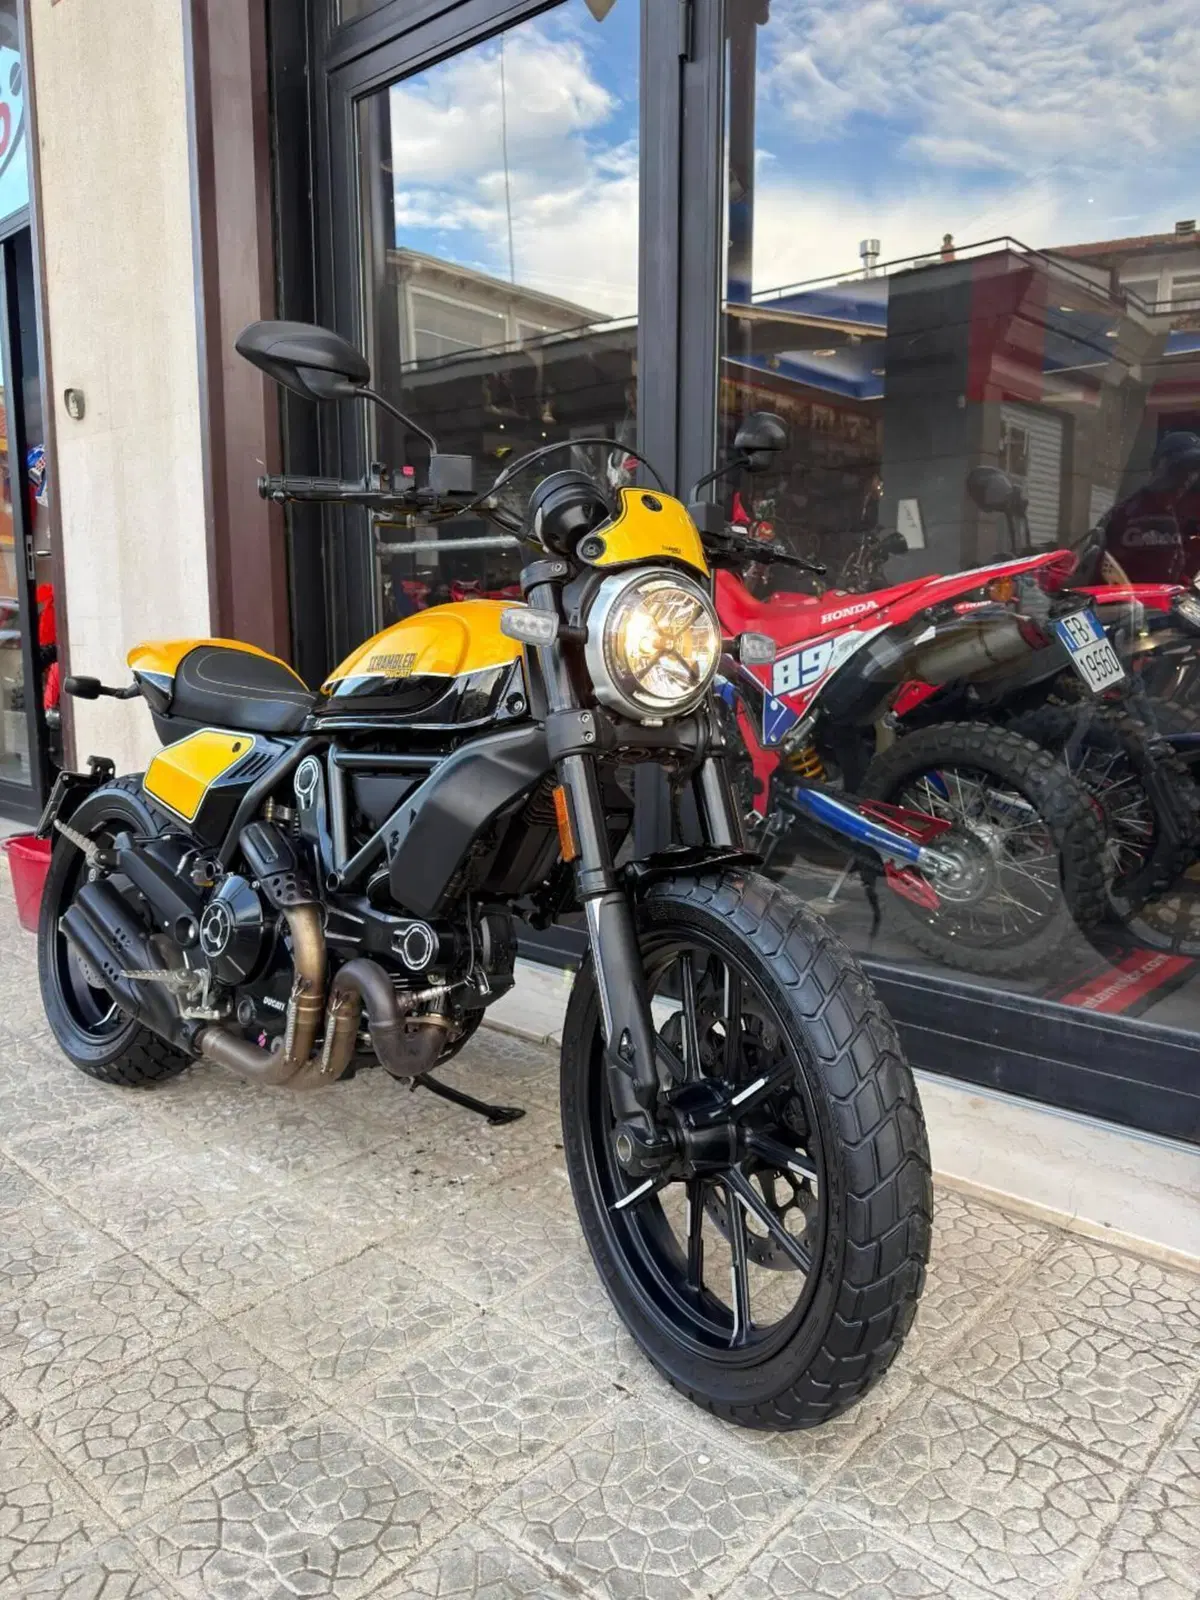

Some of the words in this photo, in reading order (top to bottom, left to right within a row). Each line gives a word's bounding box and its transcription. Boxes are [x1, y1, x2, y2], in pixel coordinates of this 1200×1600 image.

[821, 600, 879, 624] HONDA
[1064, 616, 1091, 648] FB
[367, 653, 418, 672] SCRAMBLER
[773, 641, 833, 696] 89
[1079, 645, 1120, 686] 19560
[263, 996, 286, 1011] DUCATI
